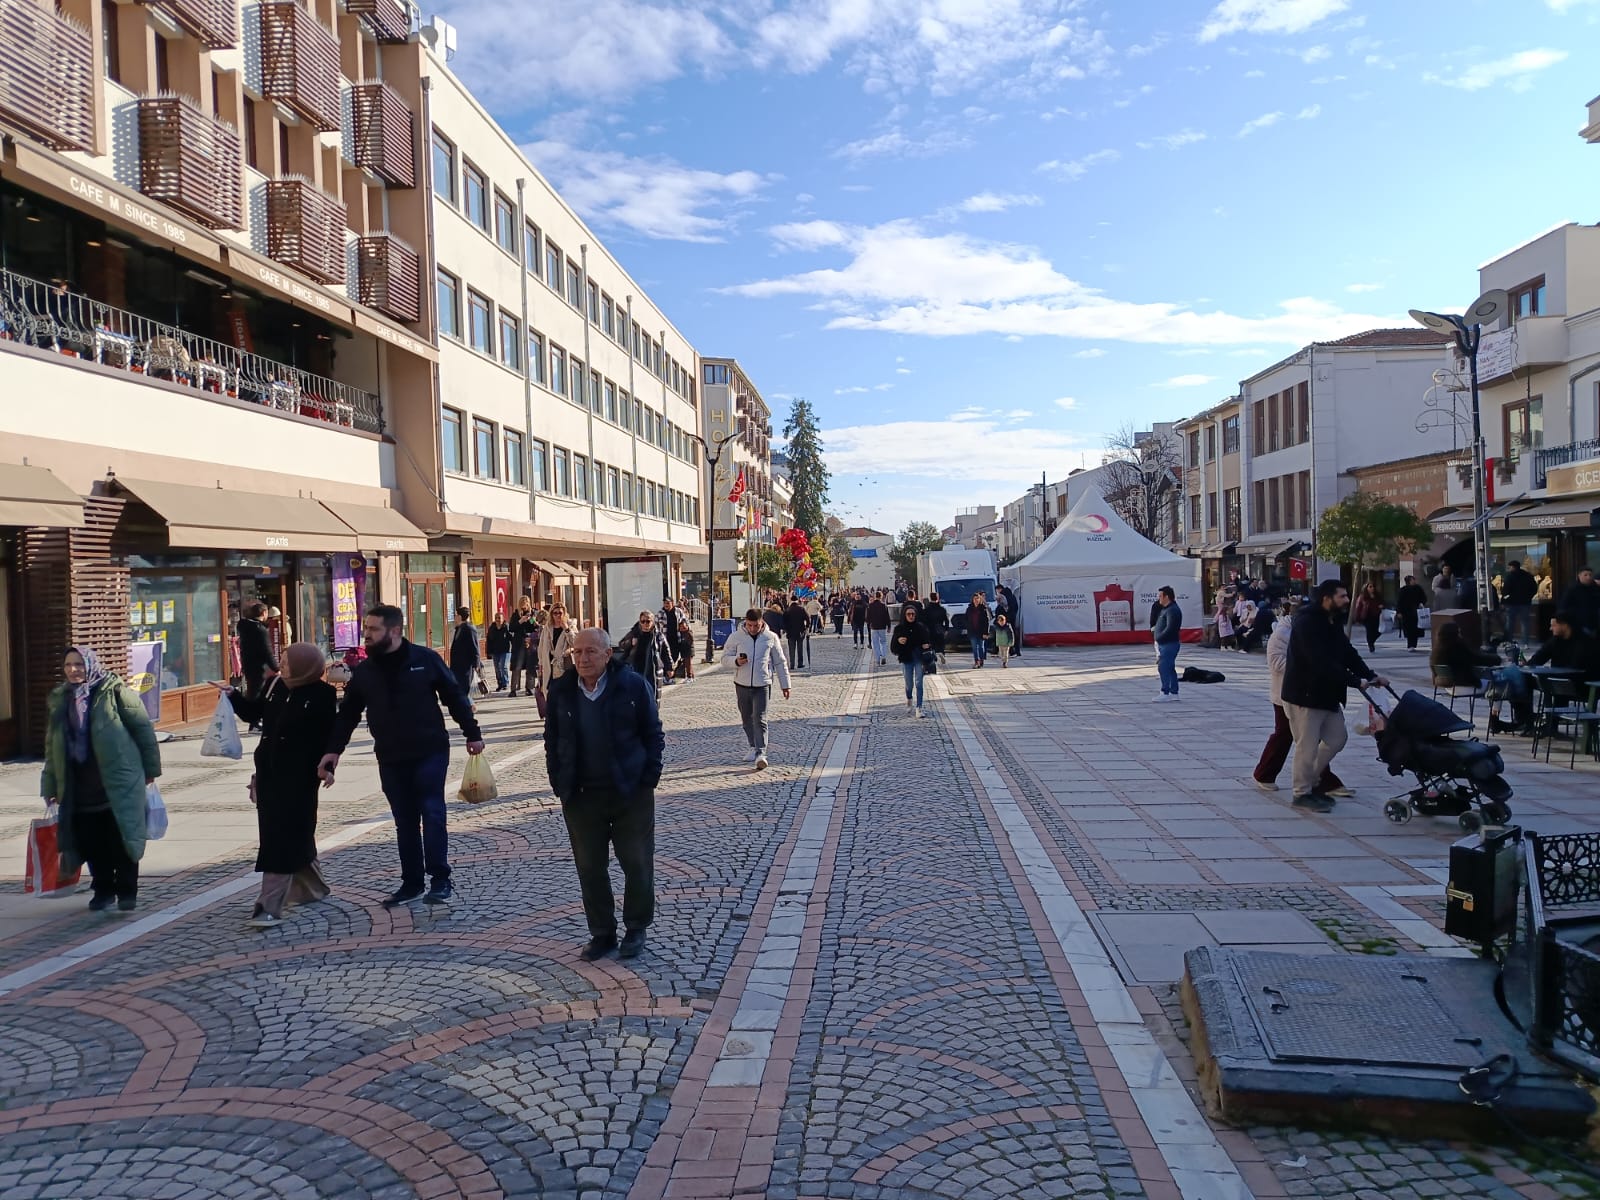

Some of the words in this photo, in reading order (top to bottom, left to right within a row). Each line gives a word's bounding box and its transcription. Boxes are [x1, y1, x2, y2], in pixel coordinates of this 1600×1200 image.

[69, 176, 104, 204] CAFE
[109, 195, 120, 211] M
[125, 203, 159, 231] SINCE
[163, 222, 186, 242] 1985
[259, 268, 280, 286] CAFE
[283, 279, 290, 291] M
[292, 283, 313, 302] SINCE
[1575, 469, 1600, 489] ÇİÇE
[266, 536, 289, 547] GRATİS
